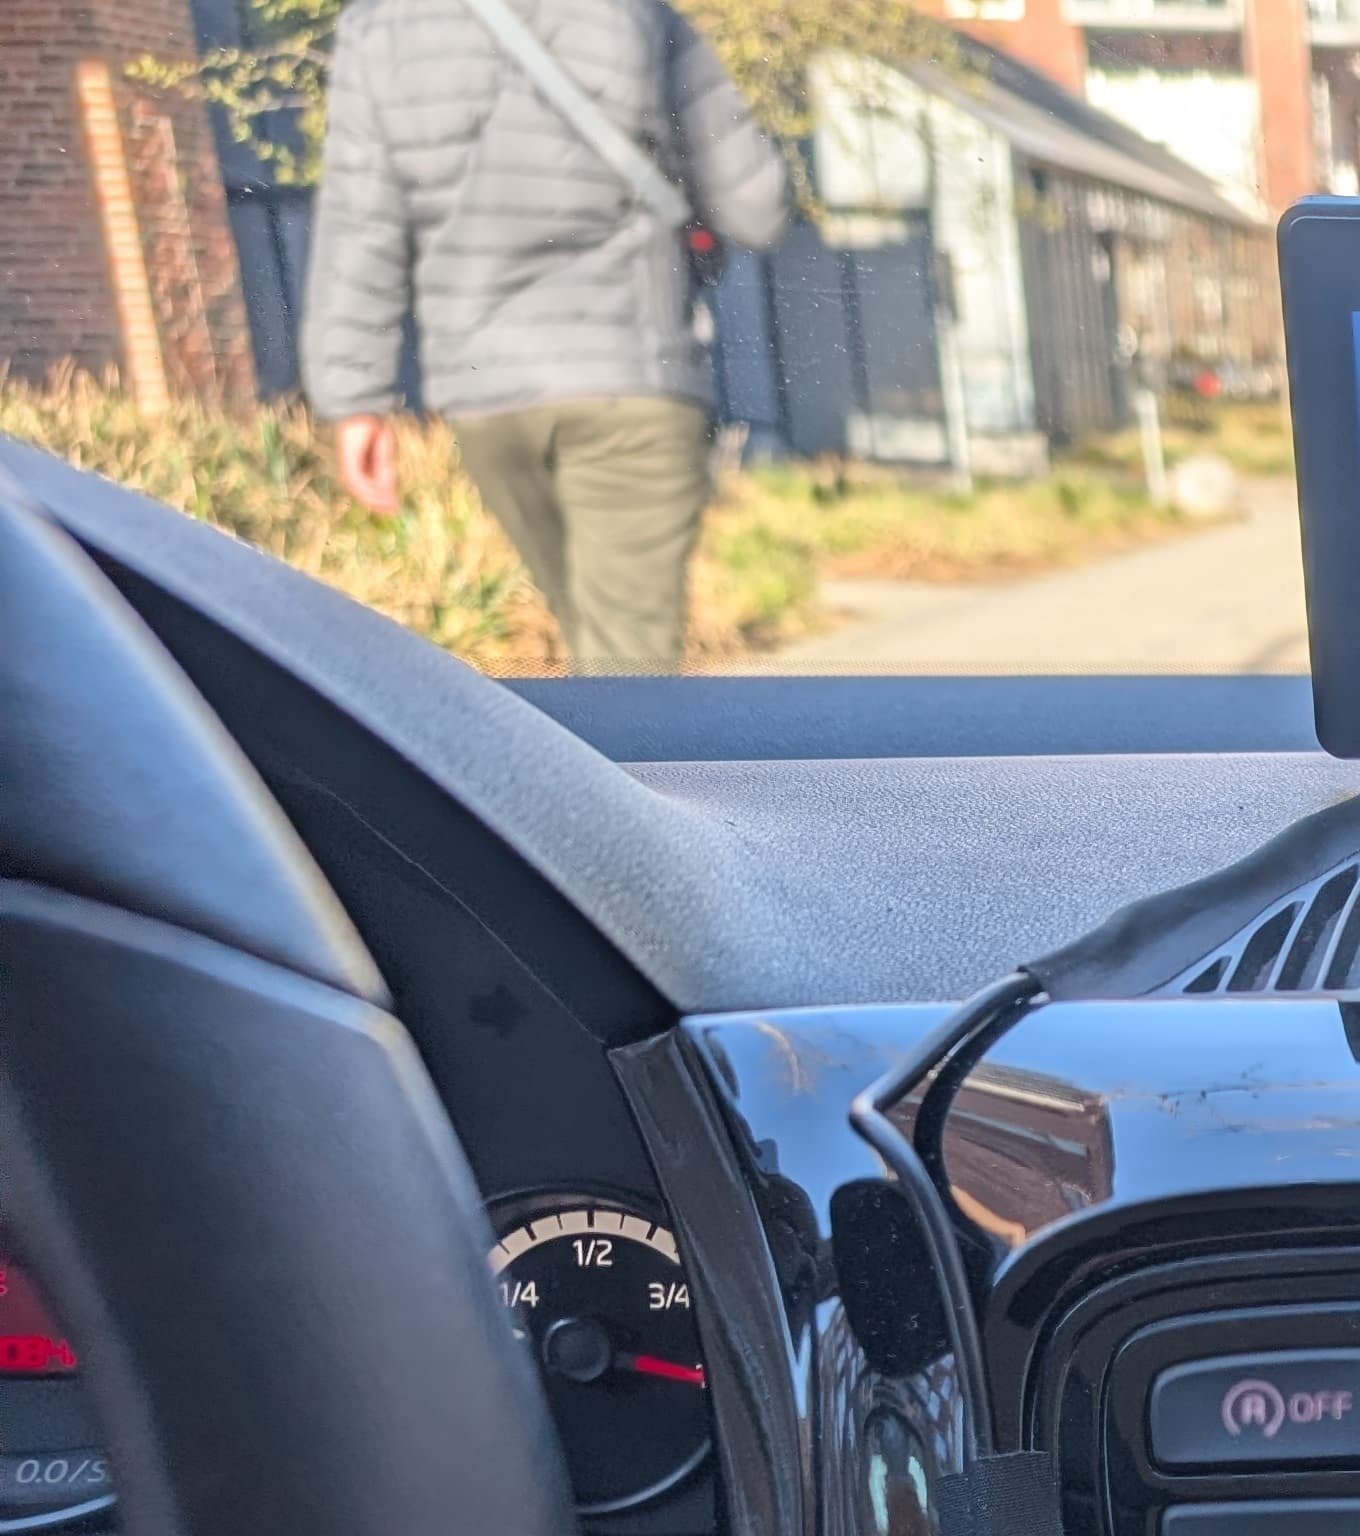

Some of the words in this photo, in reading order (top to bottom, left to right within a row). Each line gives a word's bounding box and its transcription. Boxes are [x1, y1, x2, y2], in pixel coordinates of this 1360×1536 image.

[572, 1238, 614, 1267] 1/2
[647, 1282, 691, 1310] 3/4
[1288, 1390, 1353, 1424] OFF
